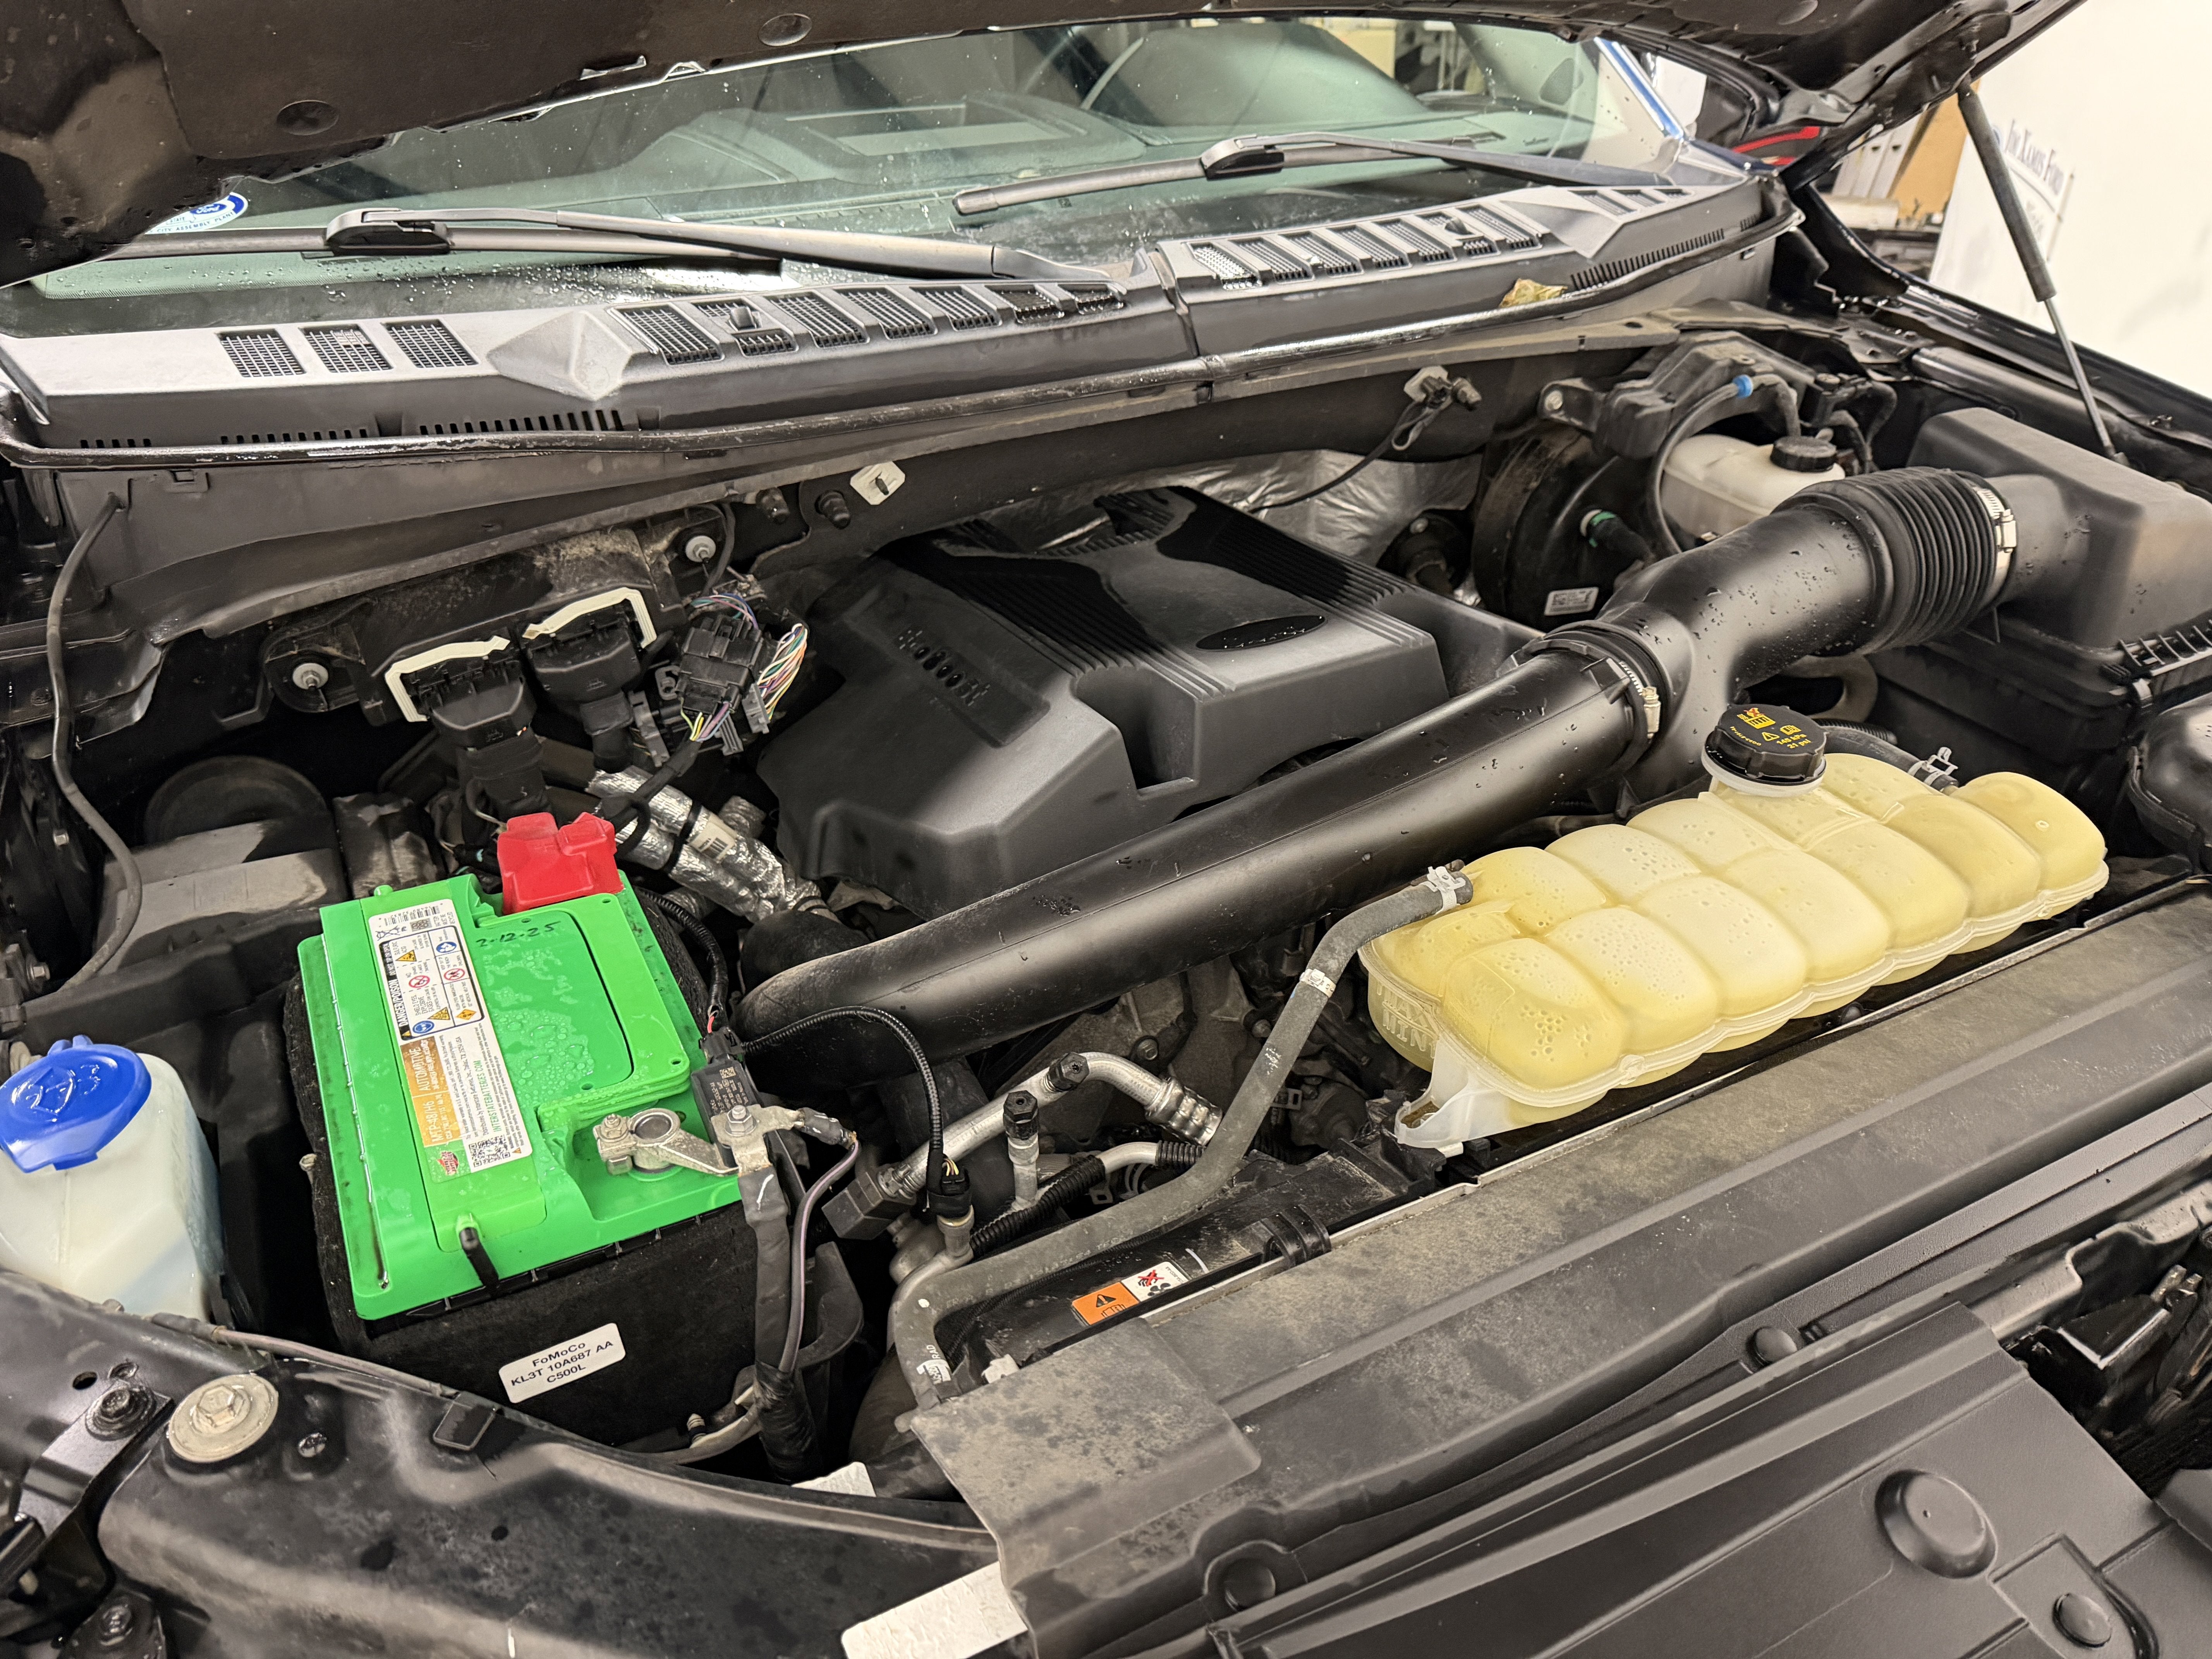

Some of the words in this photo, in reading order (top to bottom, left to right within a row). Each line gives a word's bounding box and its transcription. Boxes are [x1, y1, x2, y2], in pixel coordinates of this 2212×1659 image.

[176, 221, 210, 231] ASSEMBLY
[215, 211, 234, 222] PLANT
[387, 978, 409, 1027] DANGER/POISON
[1383, 1008, 1427, 1052] MIN
[408, 1045, 432, 1092] AUTOMOTIVE
[422, 1100, 444, 1142] MTP-48/H6
[511, 1369, 547, 1386] KL3T
[547, 1349, 591, 1372] 10A687
[596, 1341, 614, 1353] AA
[532, 1342, 586, 1367] FoMoCo
[926, 1345, 941, 1359] RAD
[546, 1364, 586, 1383] C500L
